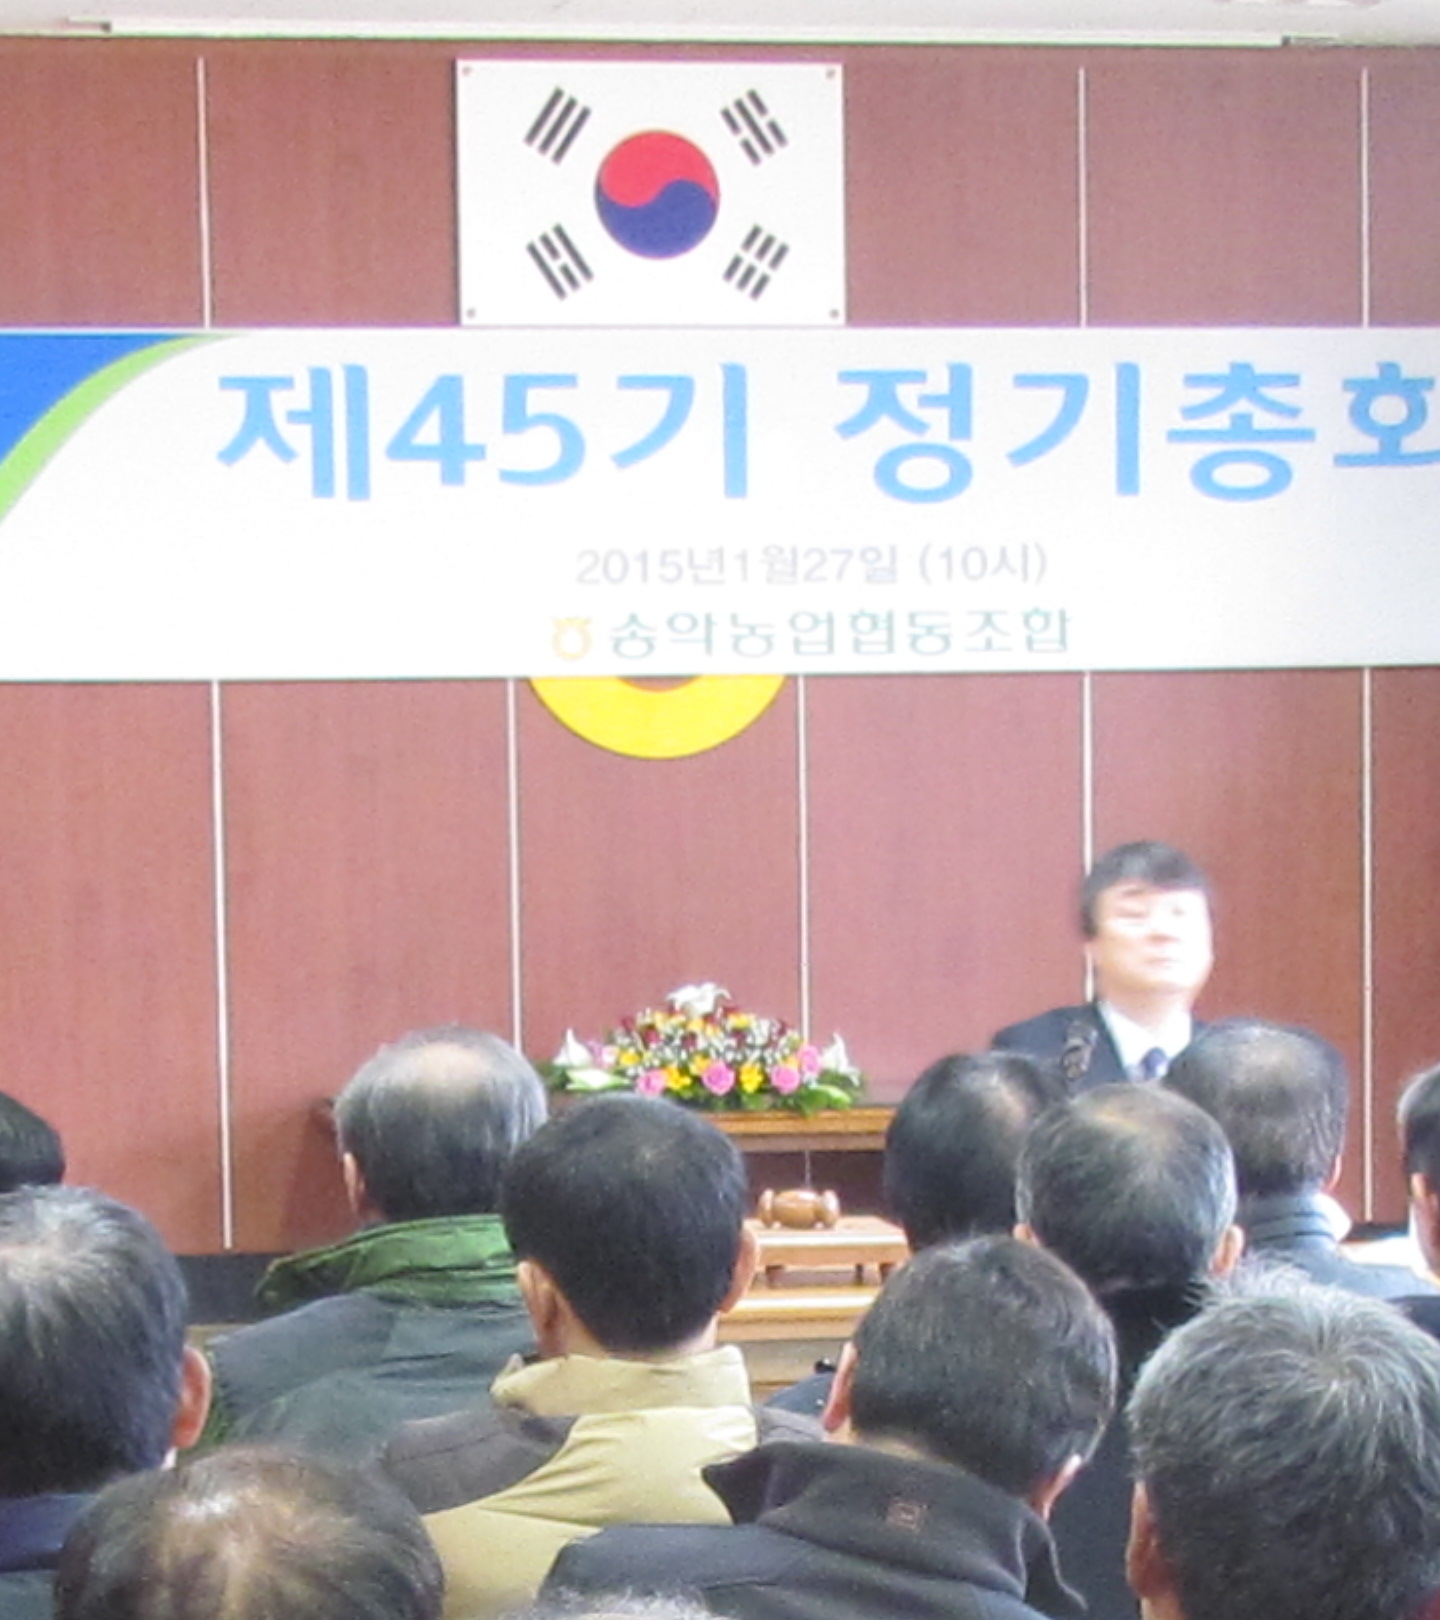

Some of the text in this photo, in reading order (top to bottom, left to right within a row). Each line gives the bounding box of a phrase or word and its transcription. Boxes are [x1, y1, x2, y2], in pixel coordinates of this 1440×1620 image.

[216, 363, 749, 502] 제45기
[576, 542, 1049, 586] 2015년1월27일 (10시)
[609, 606, 1072, 660] 송악농업협동조합
